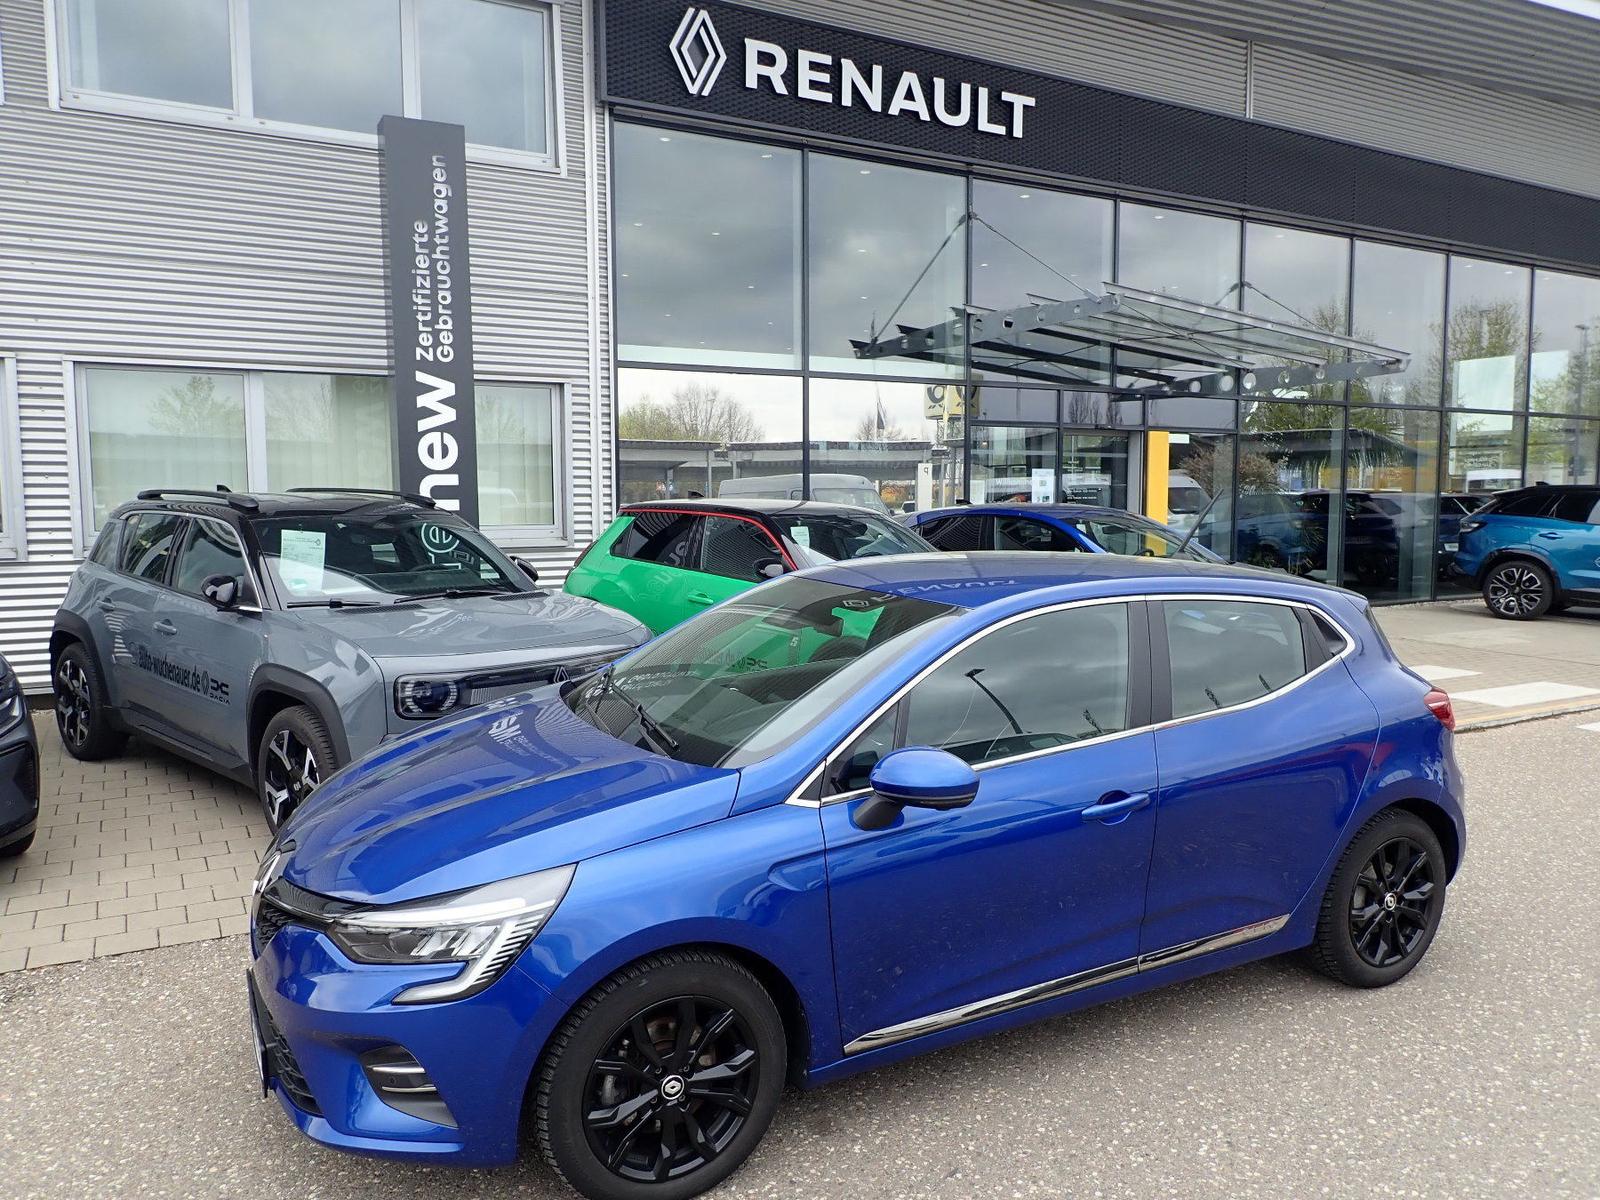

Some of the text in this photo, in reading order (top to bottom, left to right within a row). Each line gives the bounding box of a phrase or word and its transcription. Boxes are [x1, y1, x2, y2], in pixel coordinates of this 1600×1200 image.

[744, 37, 1036, 138] RENAULT
[412, 219, 434, 363] Zertifizierte
[431, 154, 454, 364] Gebrauchtwagen
